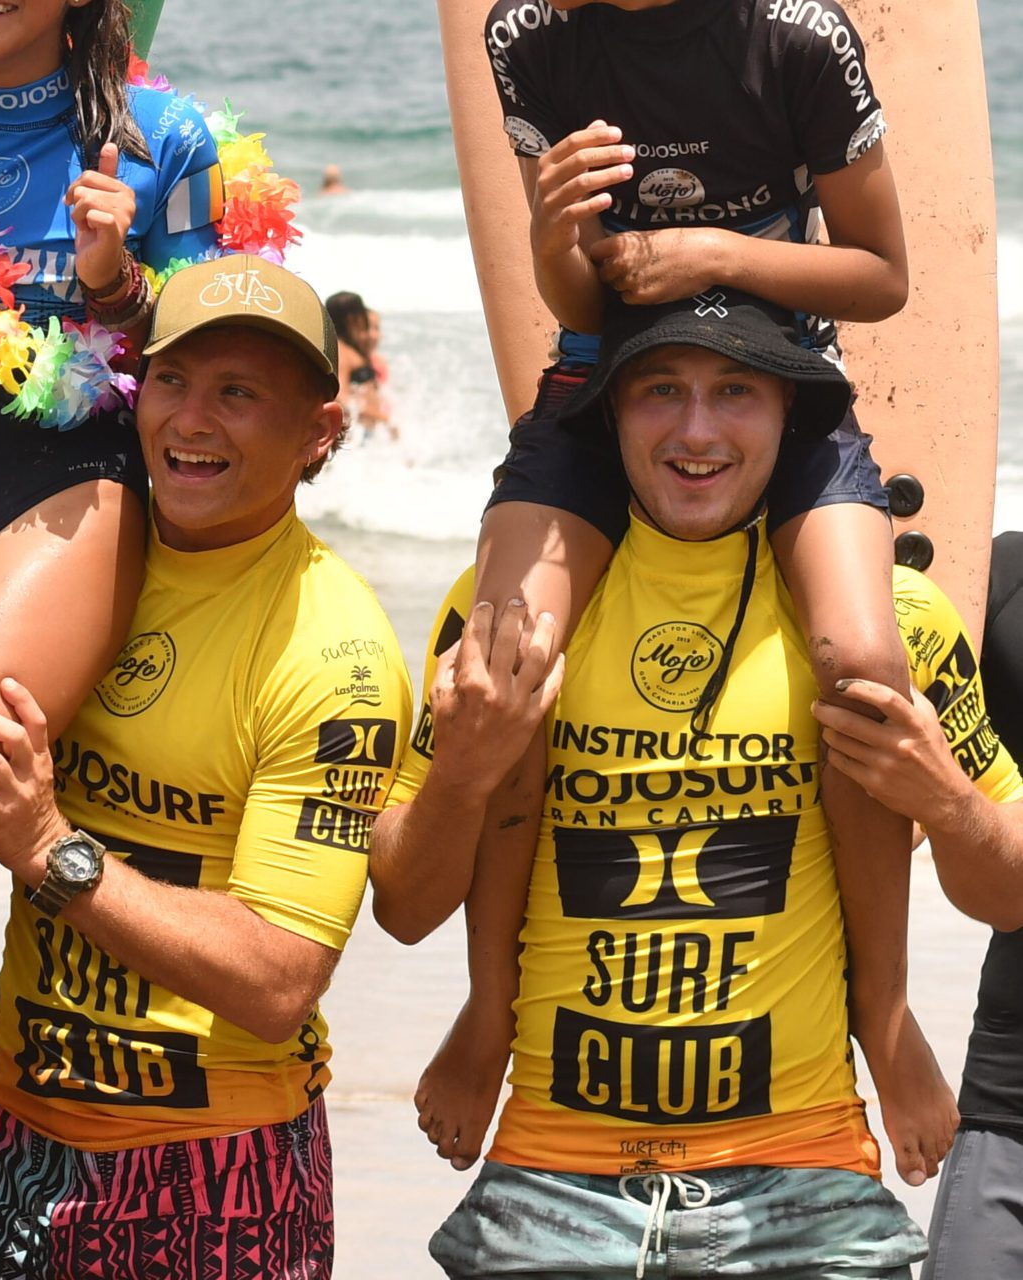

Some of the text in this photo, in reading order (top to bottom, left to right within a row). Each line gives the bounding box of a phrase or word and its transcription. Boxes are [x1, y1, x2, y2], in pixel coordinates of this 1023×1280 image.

[632, 141, 709, 159] OJOSURF
[640, 183, 696, 207] Mojo
[647, 628, 667, 644] MADE
[115, 656, 166, 686] ojo
[639, 643, 715, 685] Mojo
[651, 692, 686, 706] CANARIA
[552, 719, 797, 763] INSTRUCTOR
[54, 738, 226, 826] JOSURF
[321, 768, 384, 806] SURF
[582, 930, 756, 1014] SURF
[577, 1028, 743, 1115] CLUB
